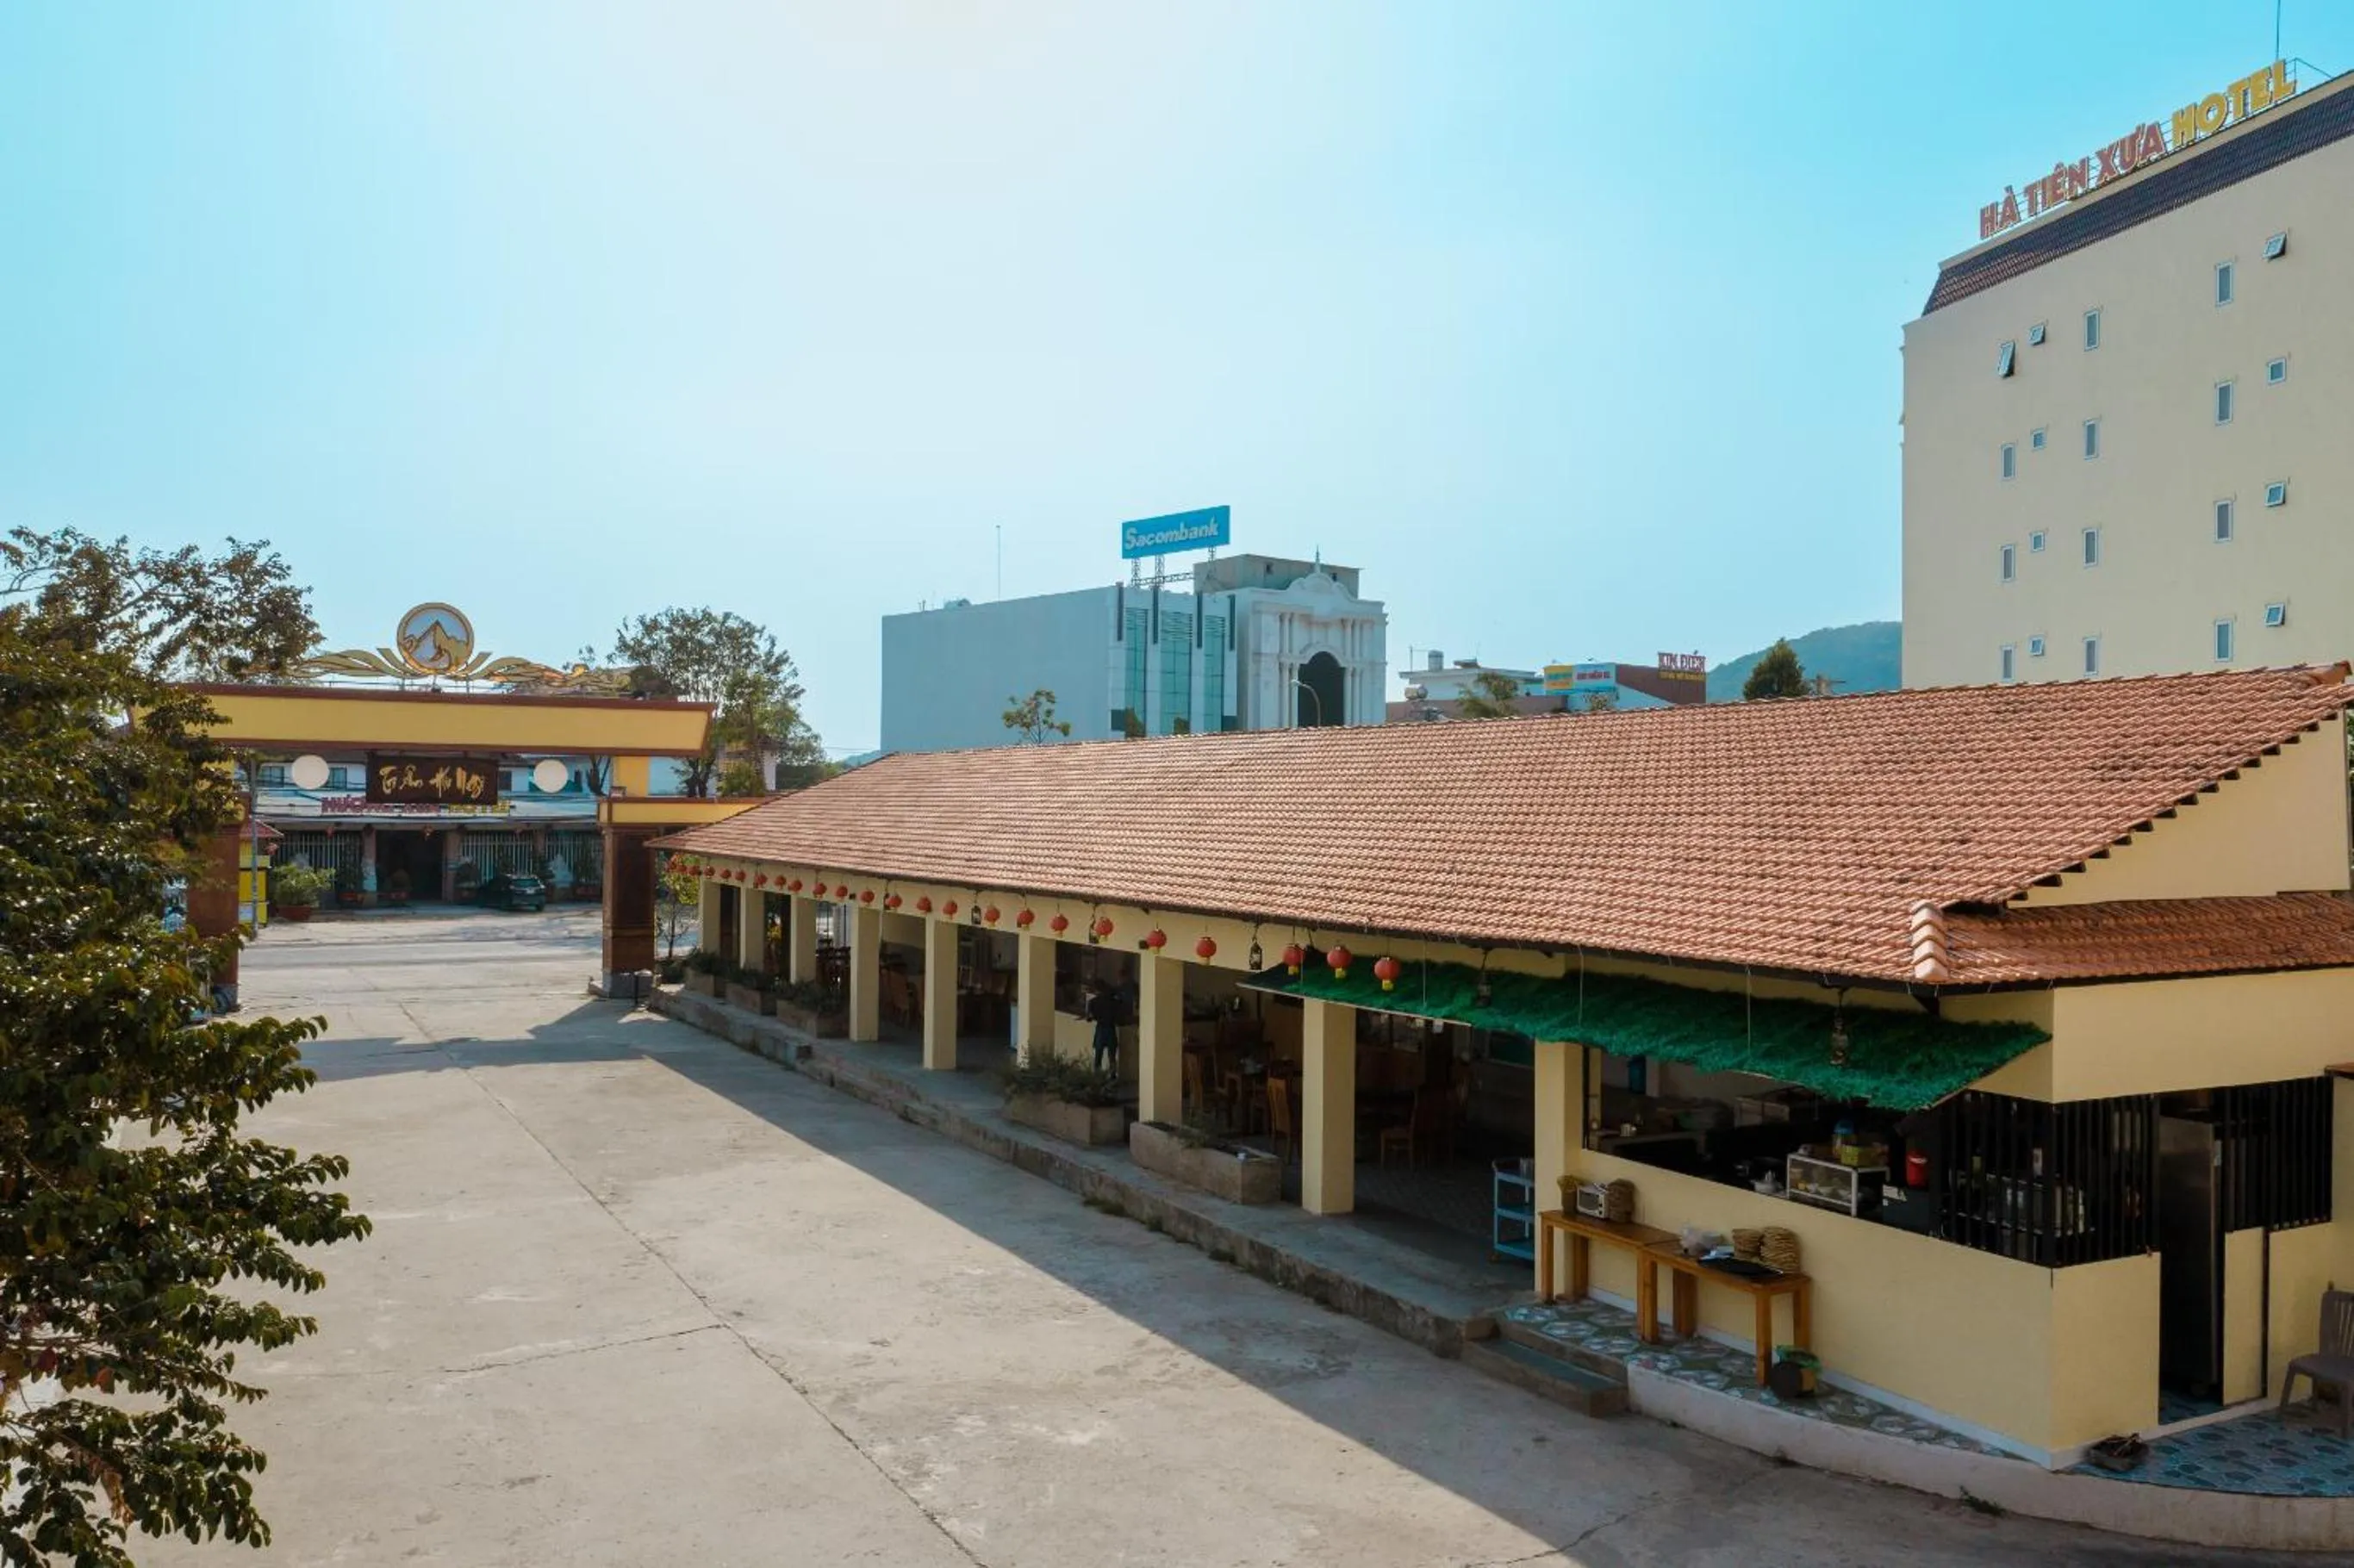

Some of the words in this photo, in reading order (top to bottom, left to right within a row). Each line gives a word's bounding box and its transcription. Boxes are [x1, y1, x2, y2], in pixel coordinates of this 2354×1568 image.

[1980, 185, 2020, 239] HÀ
[2023, 157, 2089, 217] TIÊN
[2096, 121, 2168, 184] XƯA
[2170, 59, 2296, 147] HOTEL
[1125, 516, 1218, 549] Sacombank
